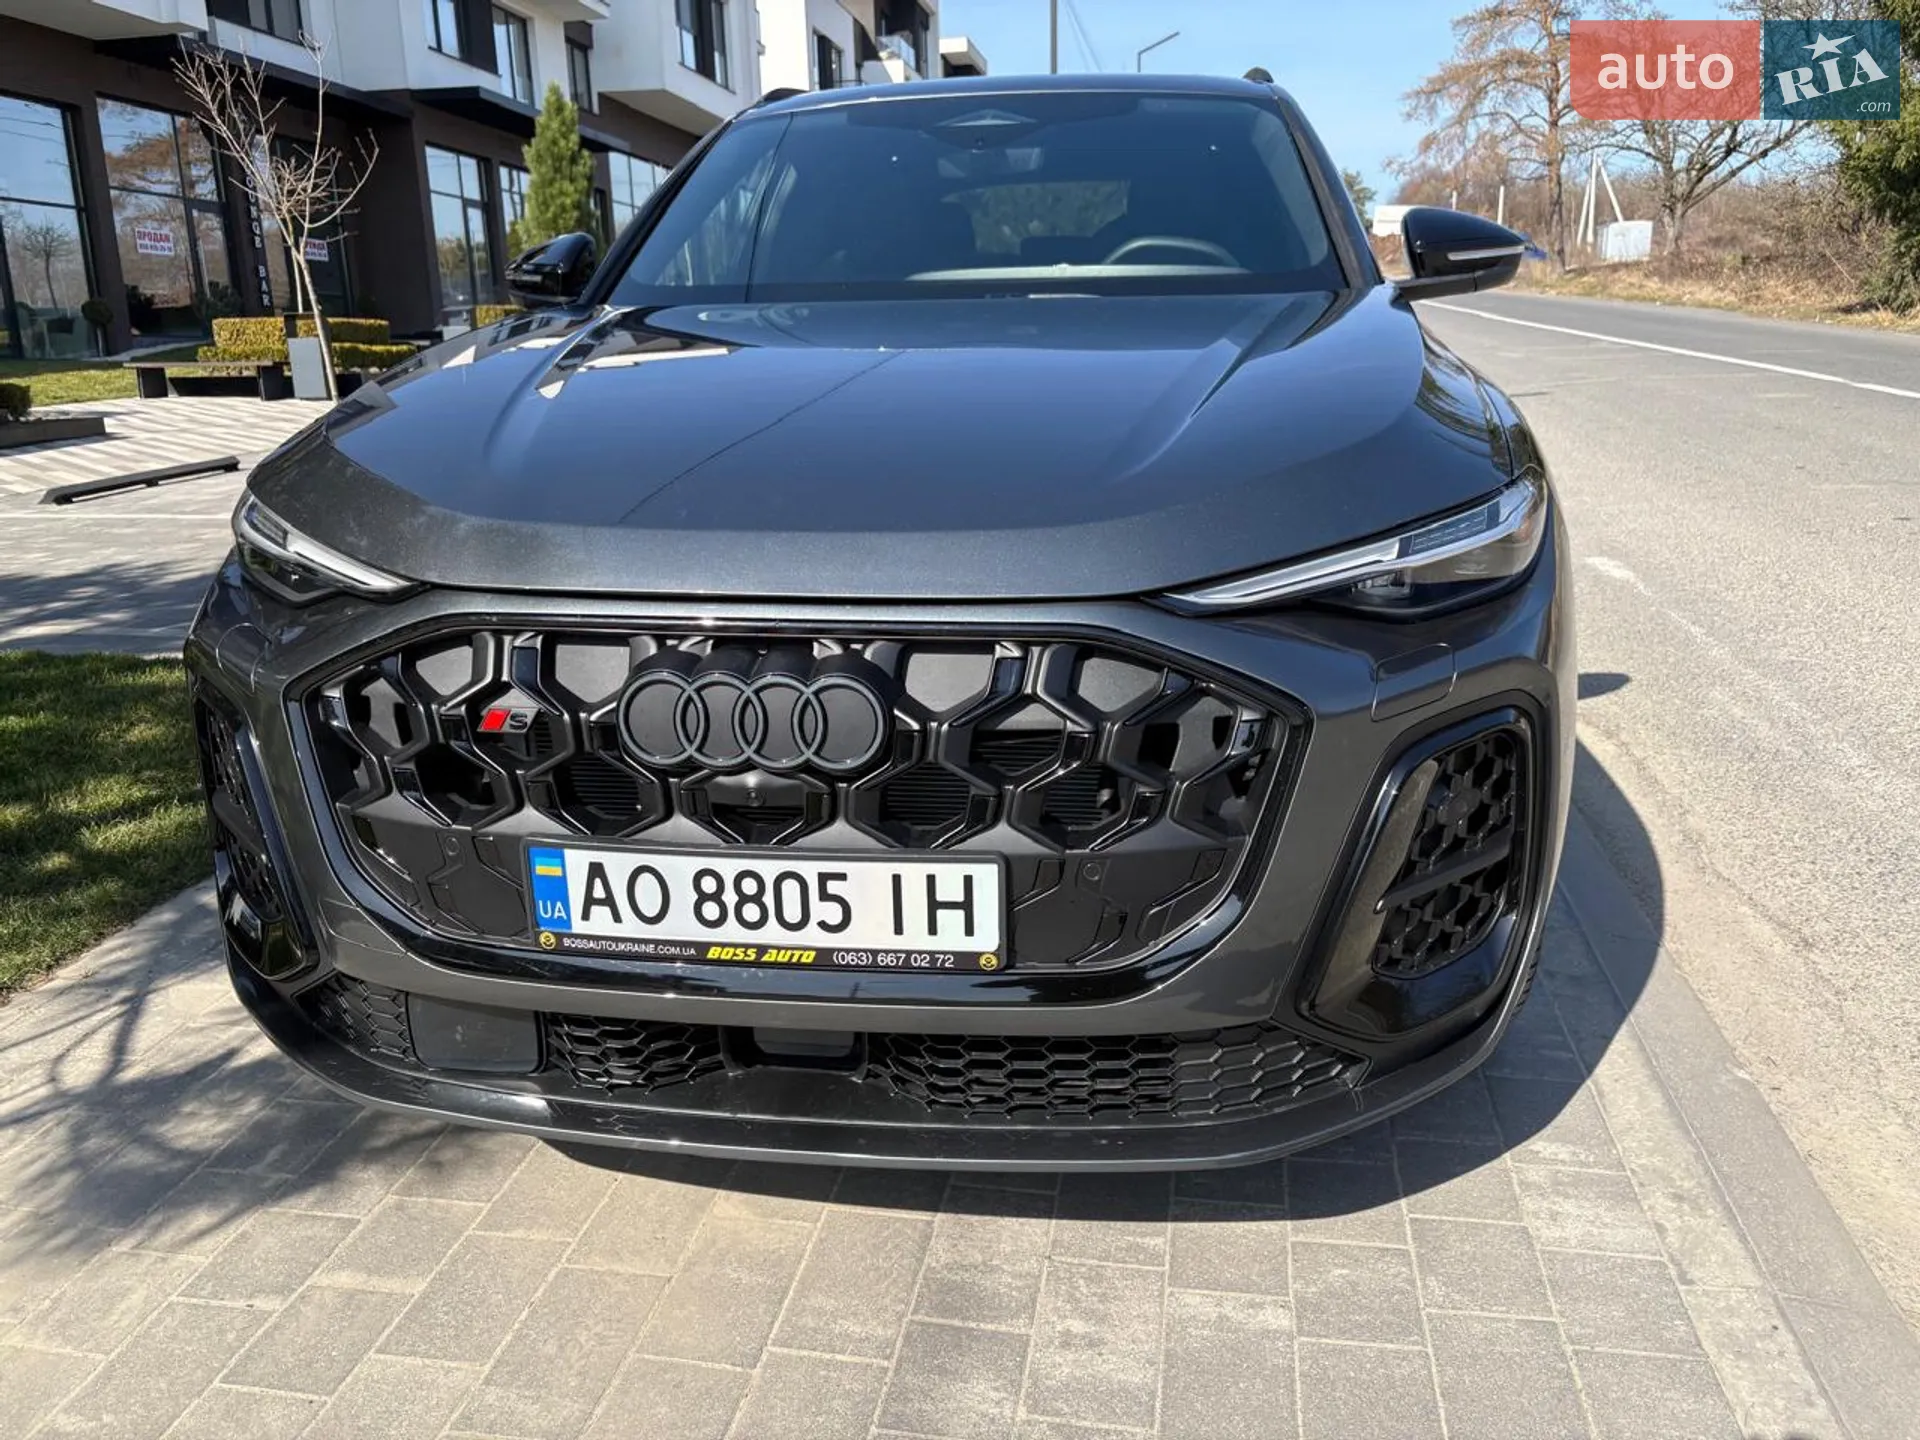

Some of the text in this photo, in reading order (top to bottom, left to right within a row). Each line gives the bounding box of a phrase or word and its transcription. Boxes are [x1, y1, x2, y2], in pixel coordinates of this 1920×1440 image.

[244, 170, 271, 306] OUNGE BAR
[580, 861, 975, 937] AO 8805 IH
[538, 900, 568, 920] UA
[562, 937, 697, 956] BOSSAUTOUKRAINE.COM.UA
[706, 946, 817, 964] BOSS AUTO
[832, 951, 955, 968] (063) 667 02 72
